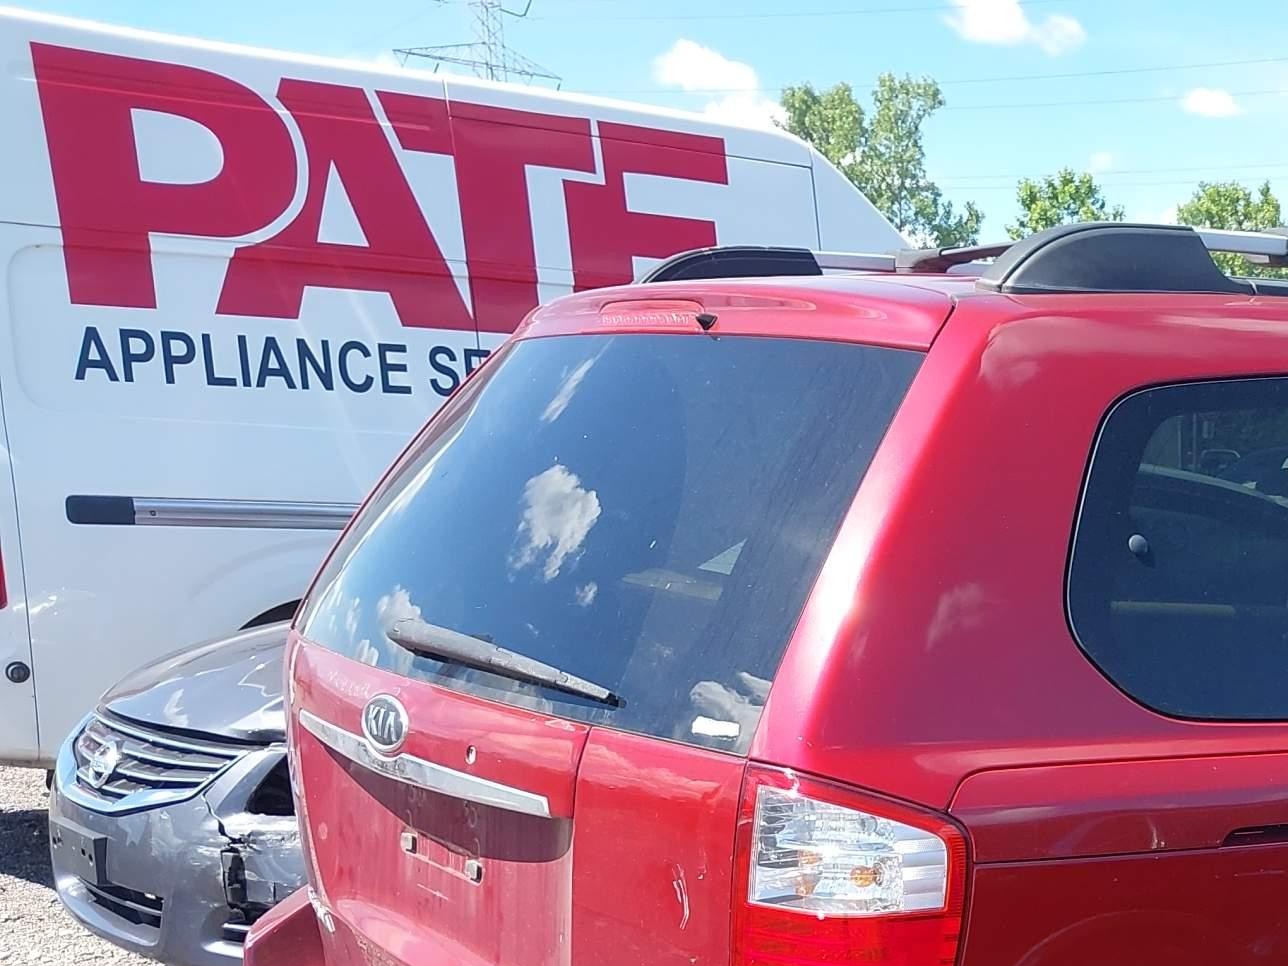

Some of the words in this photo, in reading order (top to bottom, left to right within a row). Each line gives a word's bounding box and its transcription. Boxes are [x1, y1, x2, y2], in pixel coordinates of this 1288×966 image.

[29, 41, 729, 334] PATE
[74, 326, 413, 395] APPLIANCE
[367, 703, 398, 742] KIA
